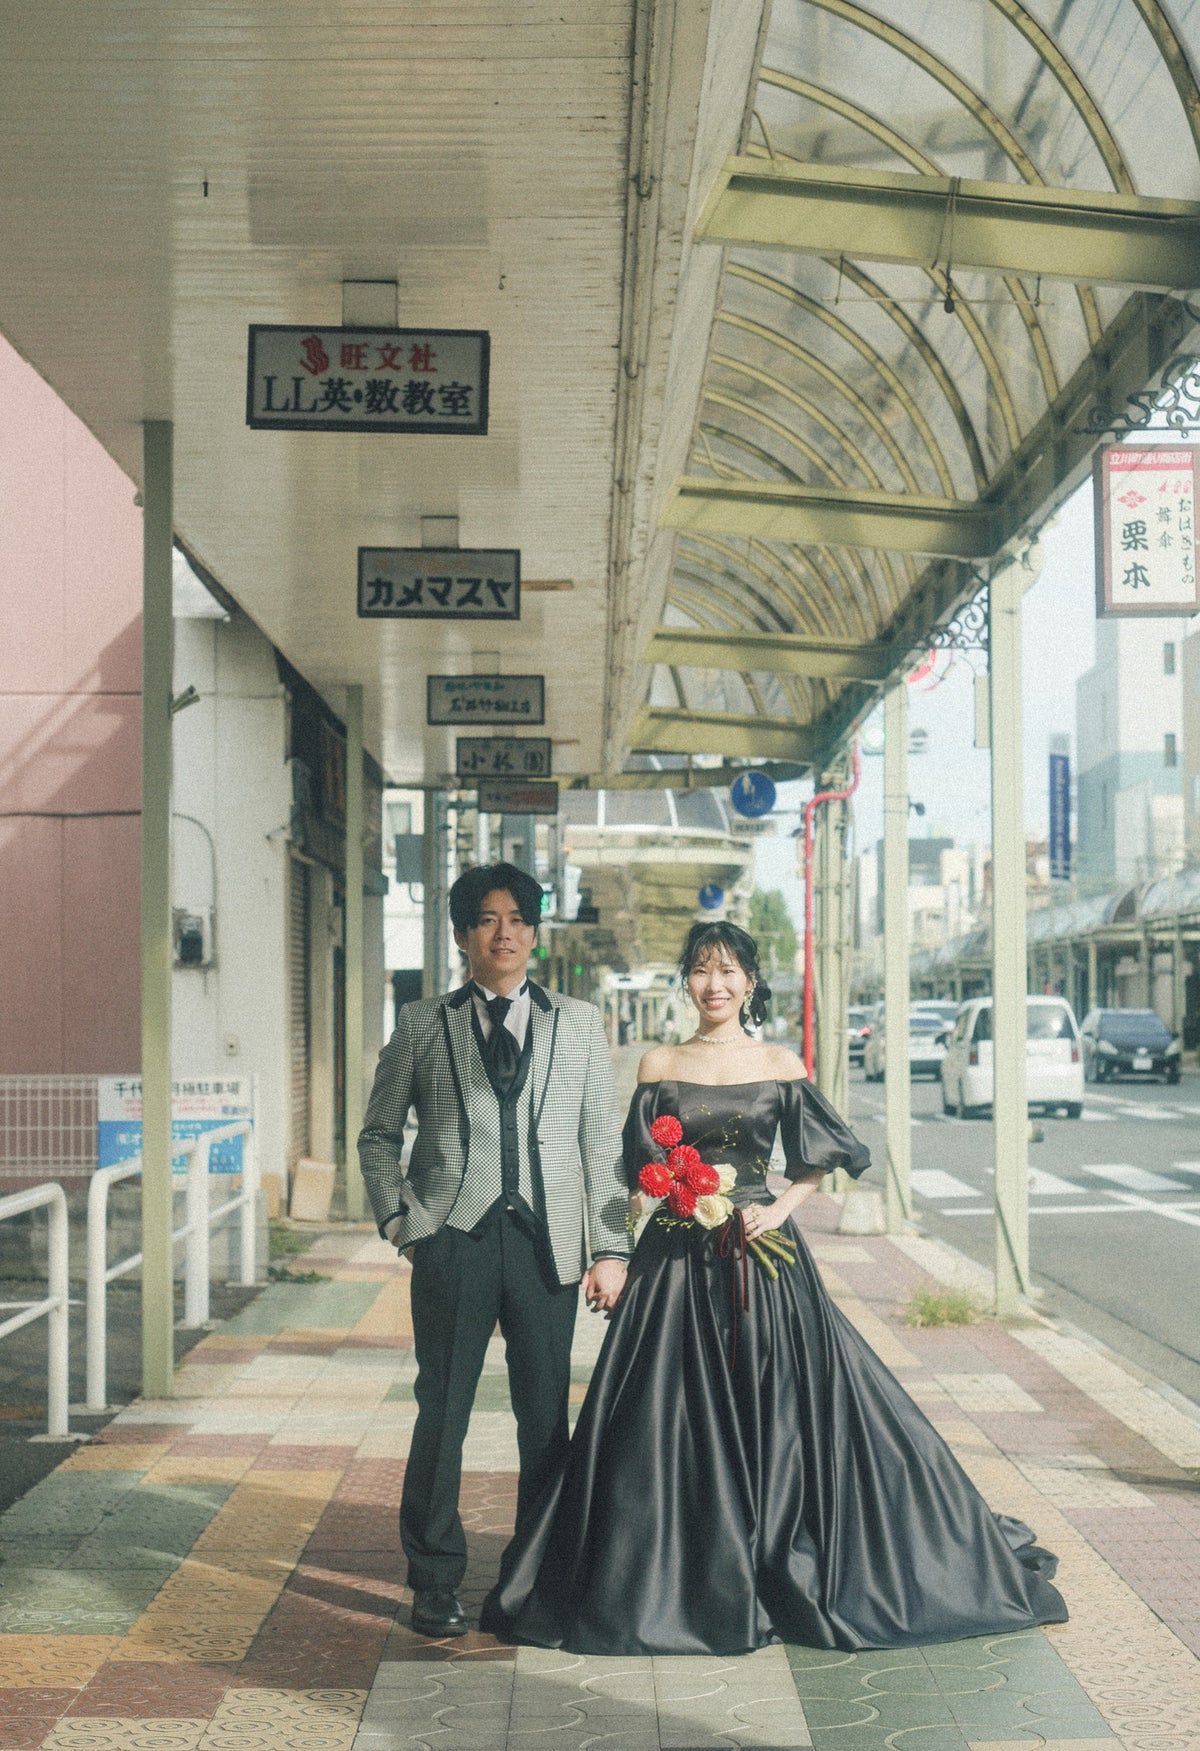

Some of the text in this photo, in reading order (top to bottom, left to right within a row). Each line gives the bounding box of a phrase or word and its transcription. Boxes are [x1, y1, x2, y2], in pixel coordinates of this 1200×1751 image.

[339, 343, 438, 373] 旺文社
[1178, 498, 1195, 585] おはきもの
[366, 577, 512, 609] カメマスヤ
[114, 1081, 241, 1098] 千代月極駐車場
